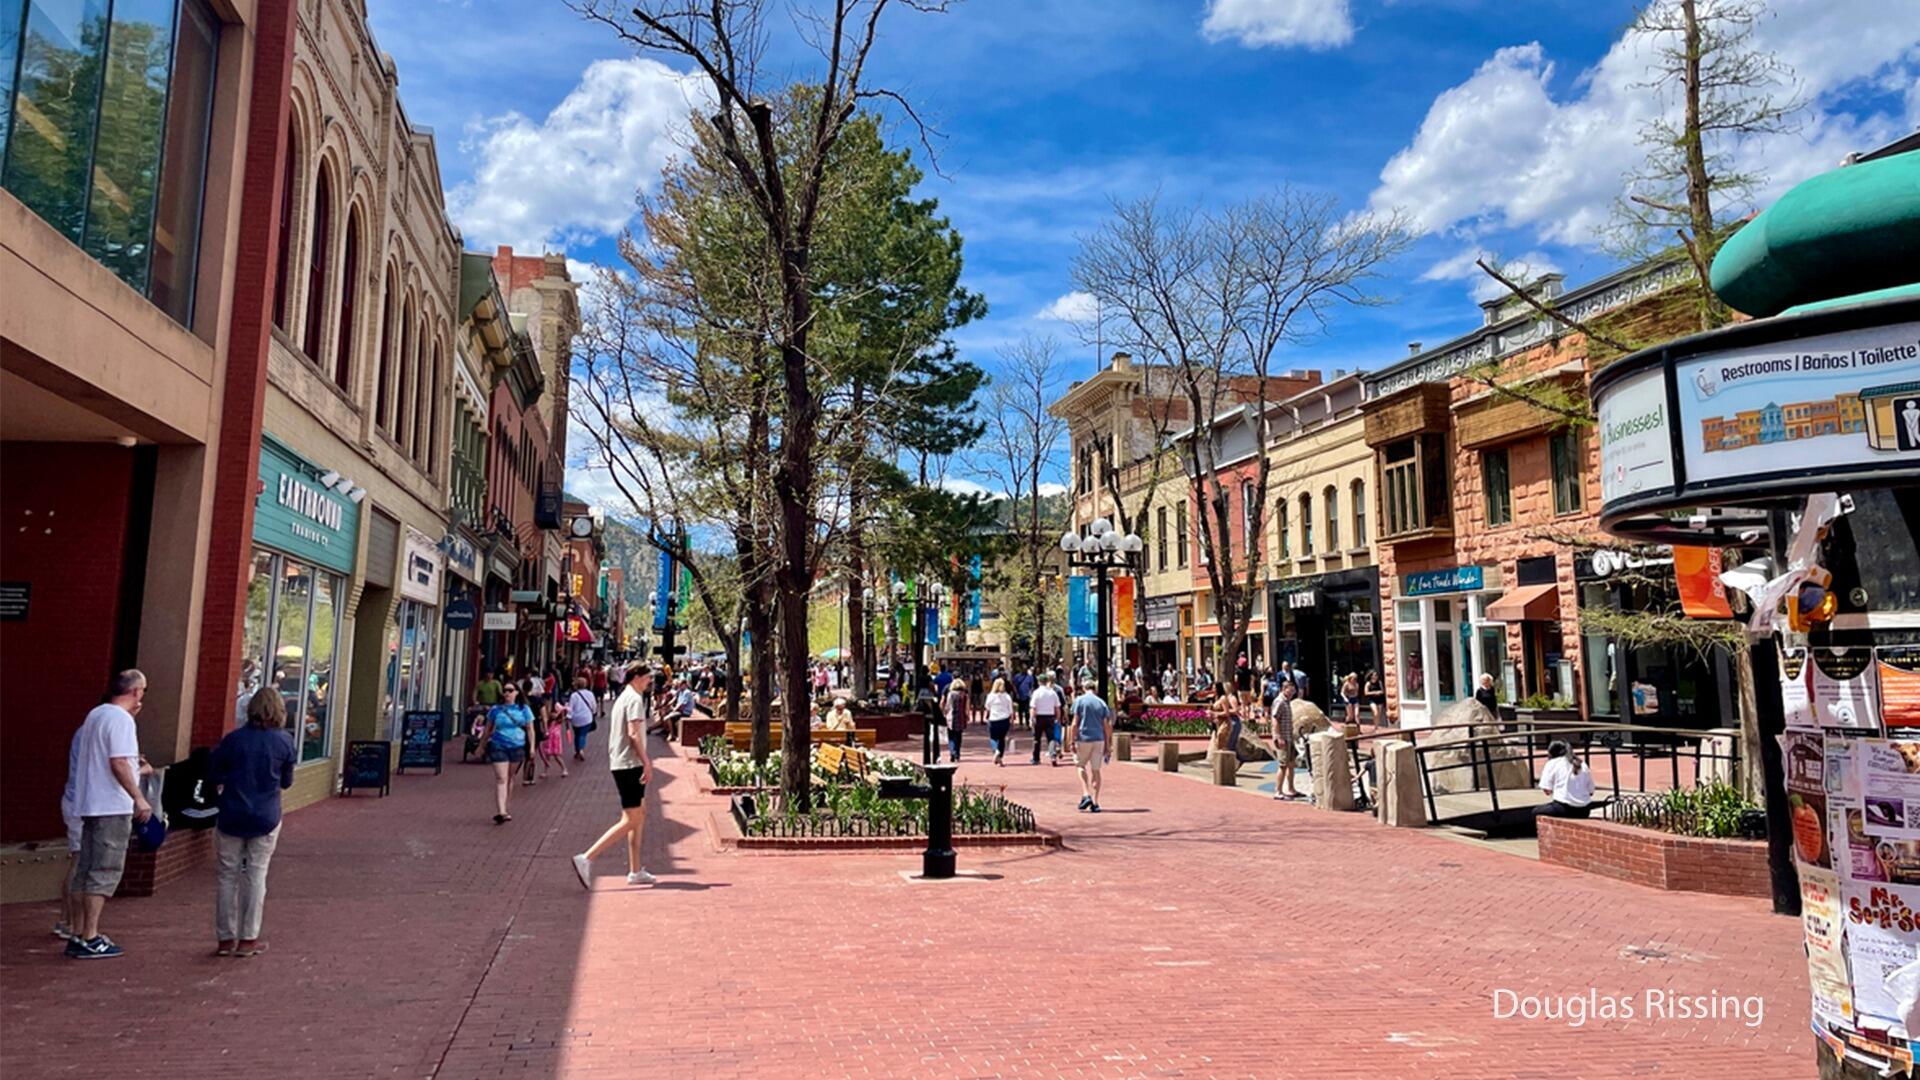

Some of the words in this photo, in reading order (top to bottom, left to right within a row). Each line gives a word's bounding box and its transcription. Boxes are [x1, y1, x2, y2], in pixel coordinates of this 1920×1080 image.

[1721, 358, 1792, 382] Restrooms
[1803, 354, 1848, 371] Baños
[1858, 344, 1916, 366] Toilette
[278, 472, 342, 532] EARTHBOUND
[1870, 886, 1904, 909] Mr.
